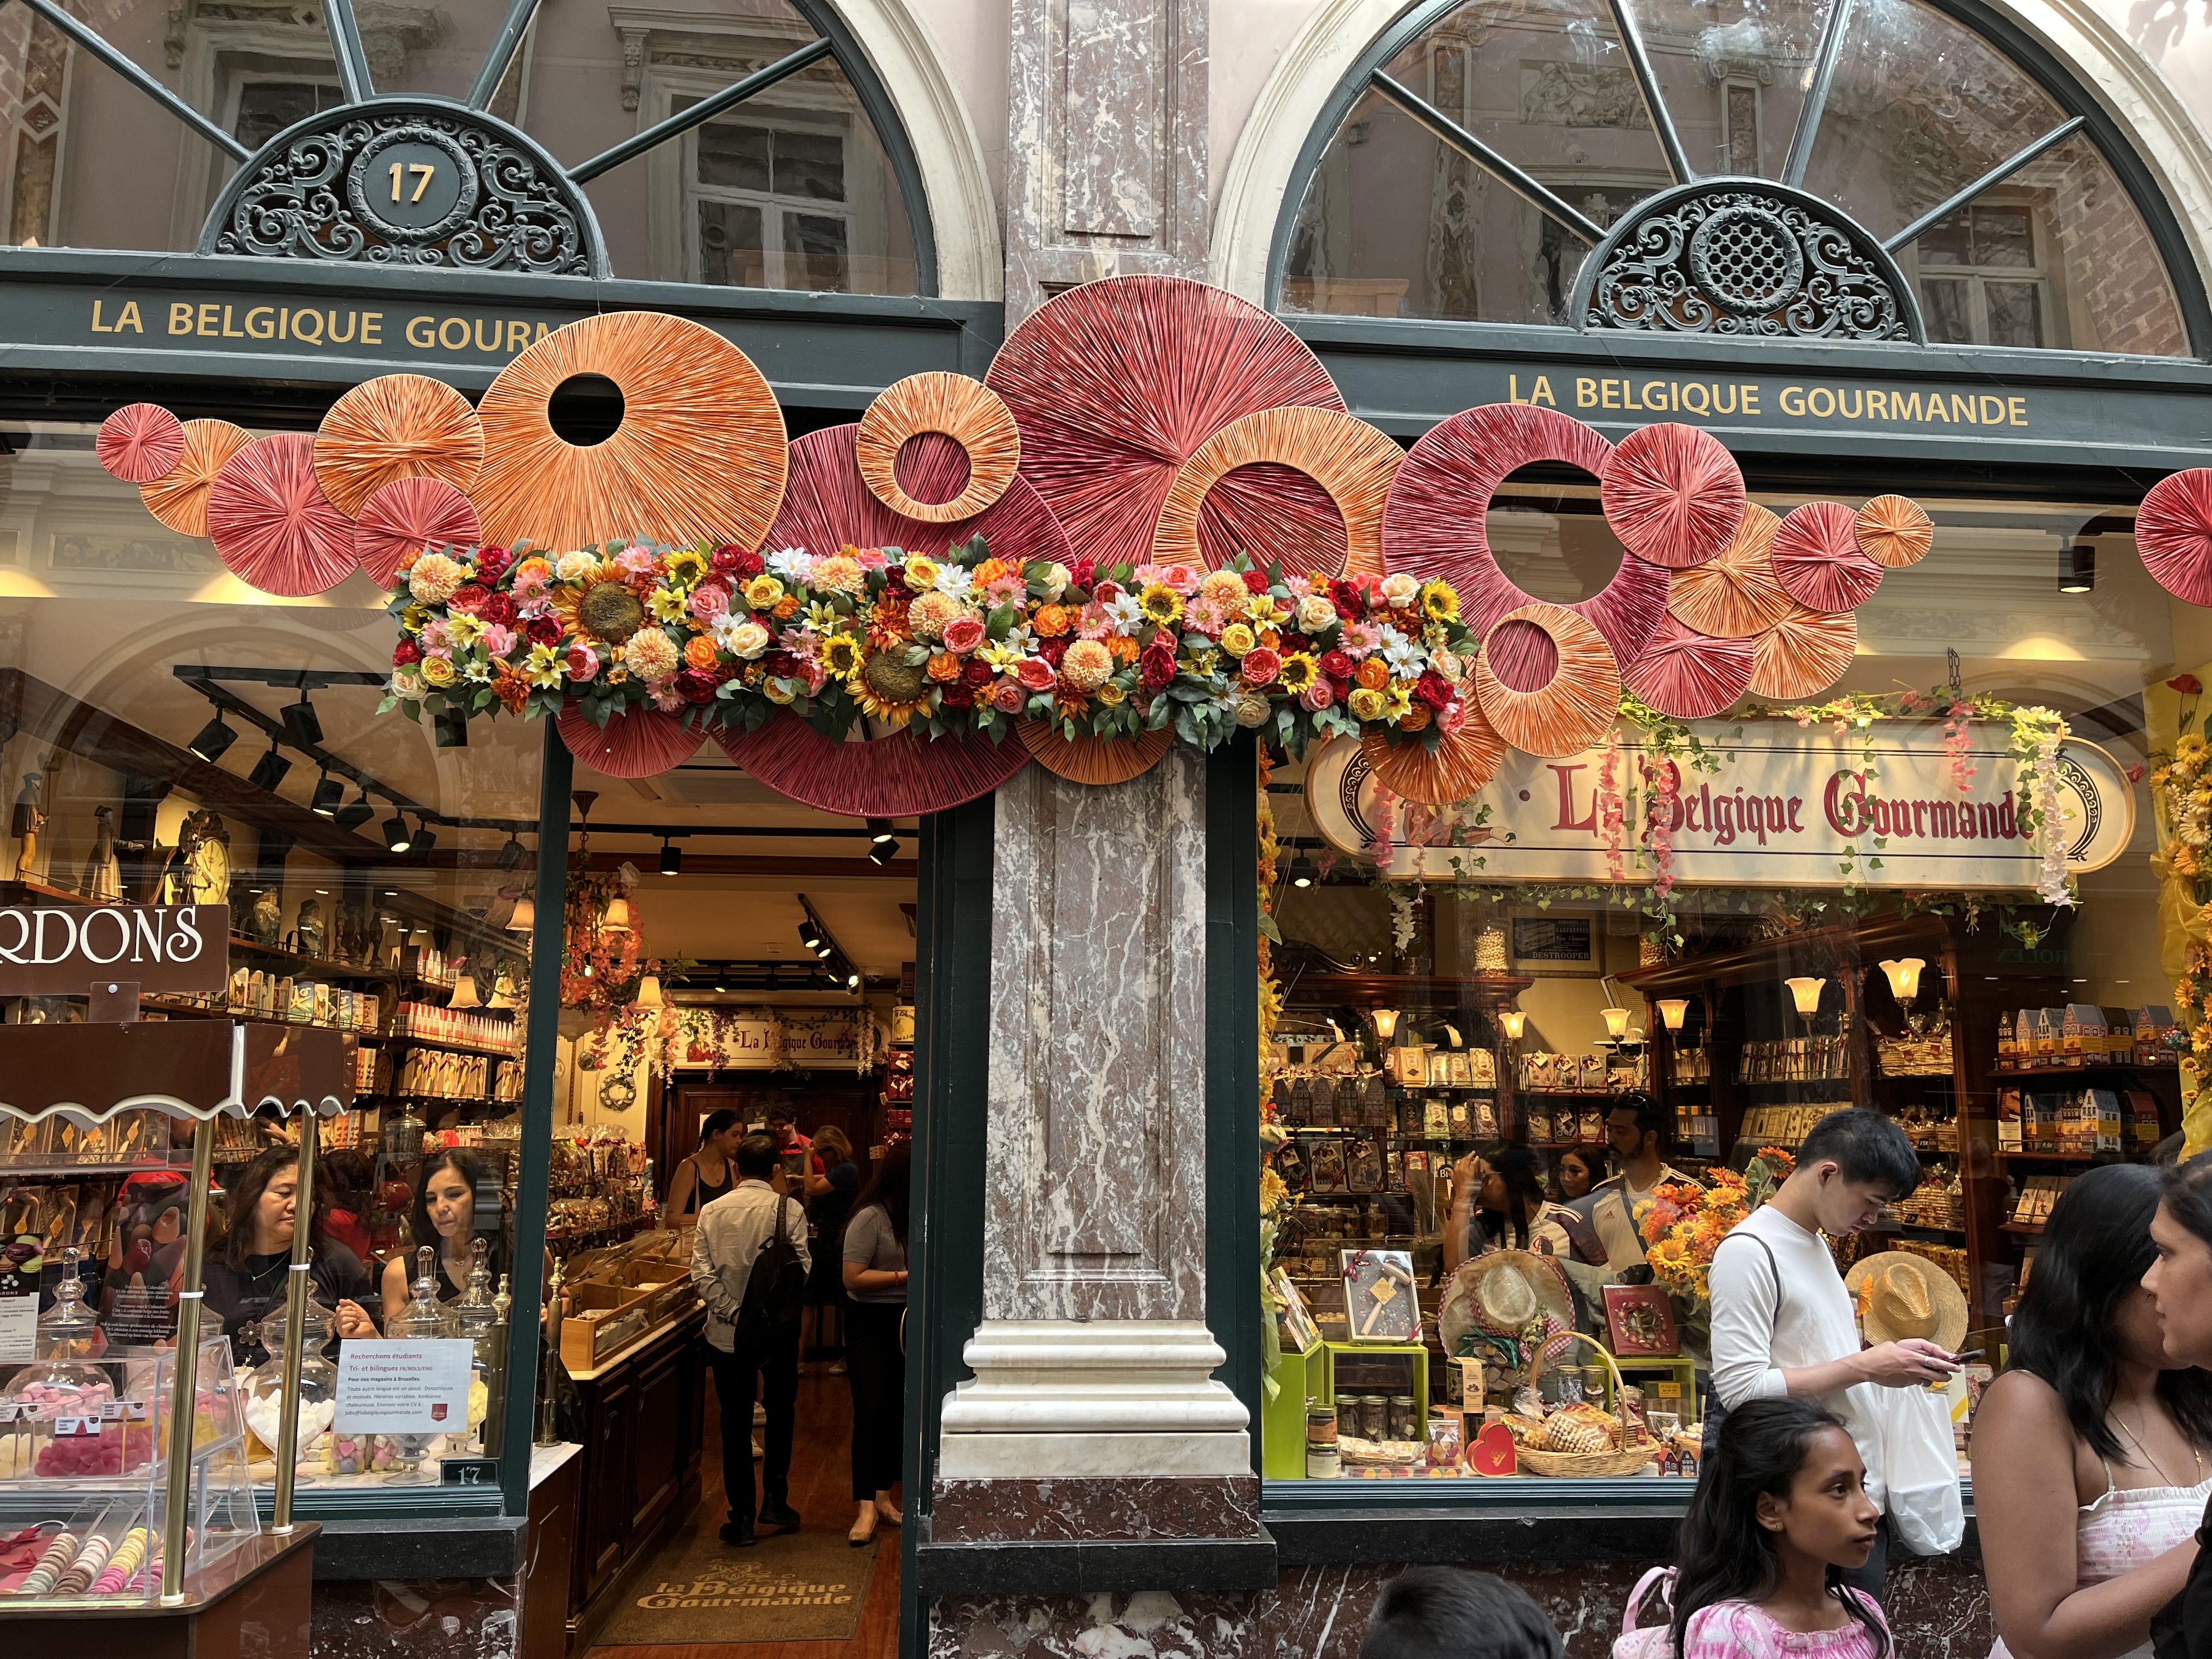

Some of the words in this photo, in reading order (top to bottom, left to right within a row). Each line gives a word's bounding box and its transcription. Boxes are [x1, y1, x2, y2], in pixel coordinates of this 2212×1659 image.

[389, 162, 435, 204] 17
[91, 299, 143, 334] LA
[168, 302, 383, 346] BELGIQUE
[1509, 374, 1556, 407] LA
[1576, 377, 1761, 417] BELGIQUE
[1779, 386, 2029, 426] GOURMANDE
[1637, 754, 1805, 846] Belgique
[1532, 951, 1590, 960] DESTROOPER
[740, 1030, 759, 1050] La
[458, 1466, 482, 1485] 17
[656, 1582, 686, 1594] la
[680, 1581, 847, 1599] Belgique
[636, 1593, 853, 1609] Gourmande
